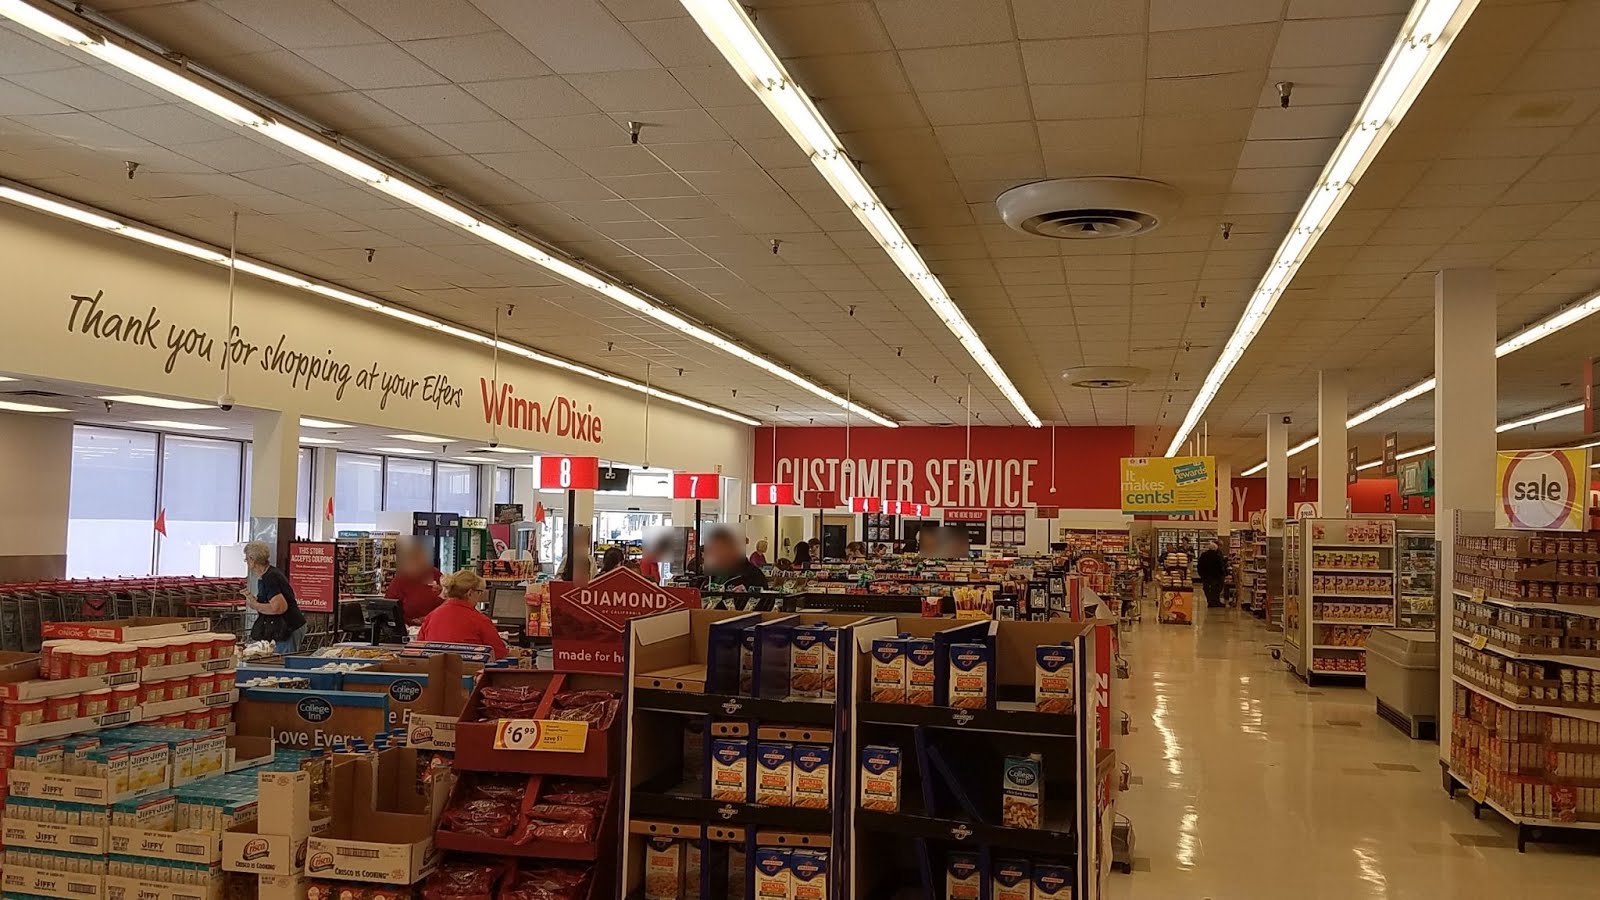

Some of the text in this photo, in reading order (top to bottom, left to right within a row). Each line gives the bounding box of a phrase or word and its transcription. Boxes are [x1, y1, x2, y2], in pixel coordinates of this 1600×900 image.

[68, 290, 463, 410] Thank you for shopping at your Elfers
[560, 458, 571, 487] 8
[1126, 469, 1136, 481] It
[690, 476, 699, 498] 7
[777, 458, 1038, 507] CUSTOMER SERVICE
[1122, 479, 1165, 491] makes
[1514, 473, 1561, 501] sale
[769, 485, 777, 503] 6
[817, 492, 822, 507] 5
[1126, 489, 1175, 504] cents!
[862, 499, 868, 512] 4
[896, 501, 901, 513] 3
[915, 504, 921, 516] 2
[299, 547, 325, 555] THIS STORE
[291, 555, 333, 564] ACCEPTS COUPONS
[580, 589, 667, 609] DIAMOND
[558, 649, 592, 661] made
[594, 651, 611, 662] for
[391, 684, 420, 697] College
[300, 703, 330, 716] College
[308, 711, 321, 720] Inn
[270, 726, 361, 747] Love Ever
[1009, 769, 1034, 780] College
[42, 784, 63, 794] JIFFY
[35, 832, 58, 842] JIFFY
[141, 839, 163, 850] JIFFY
[335, 868, 354, 876] CRISCO
[35, 878, 56, 889] JIFFY
[138, 890, 160, 900] JIFFY
